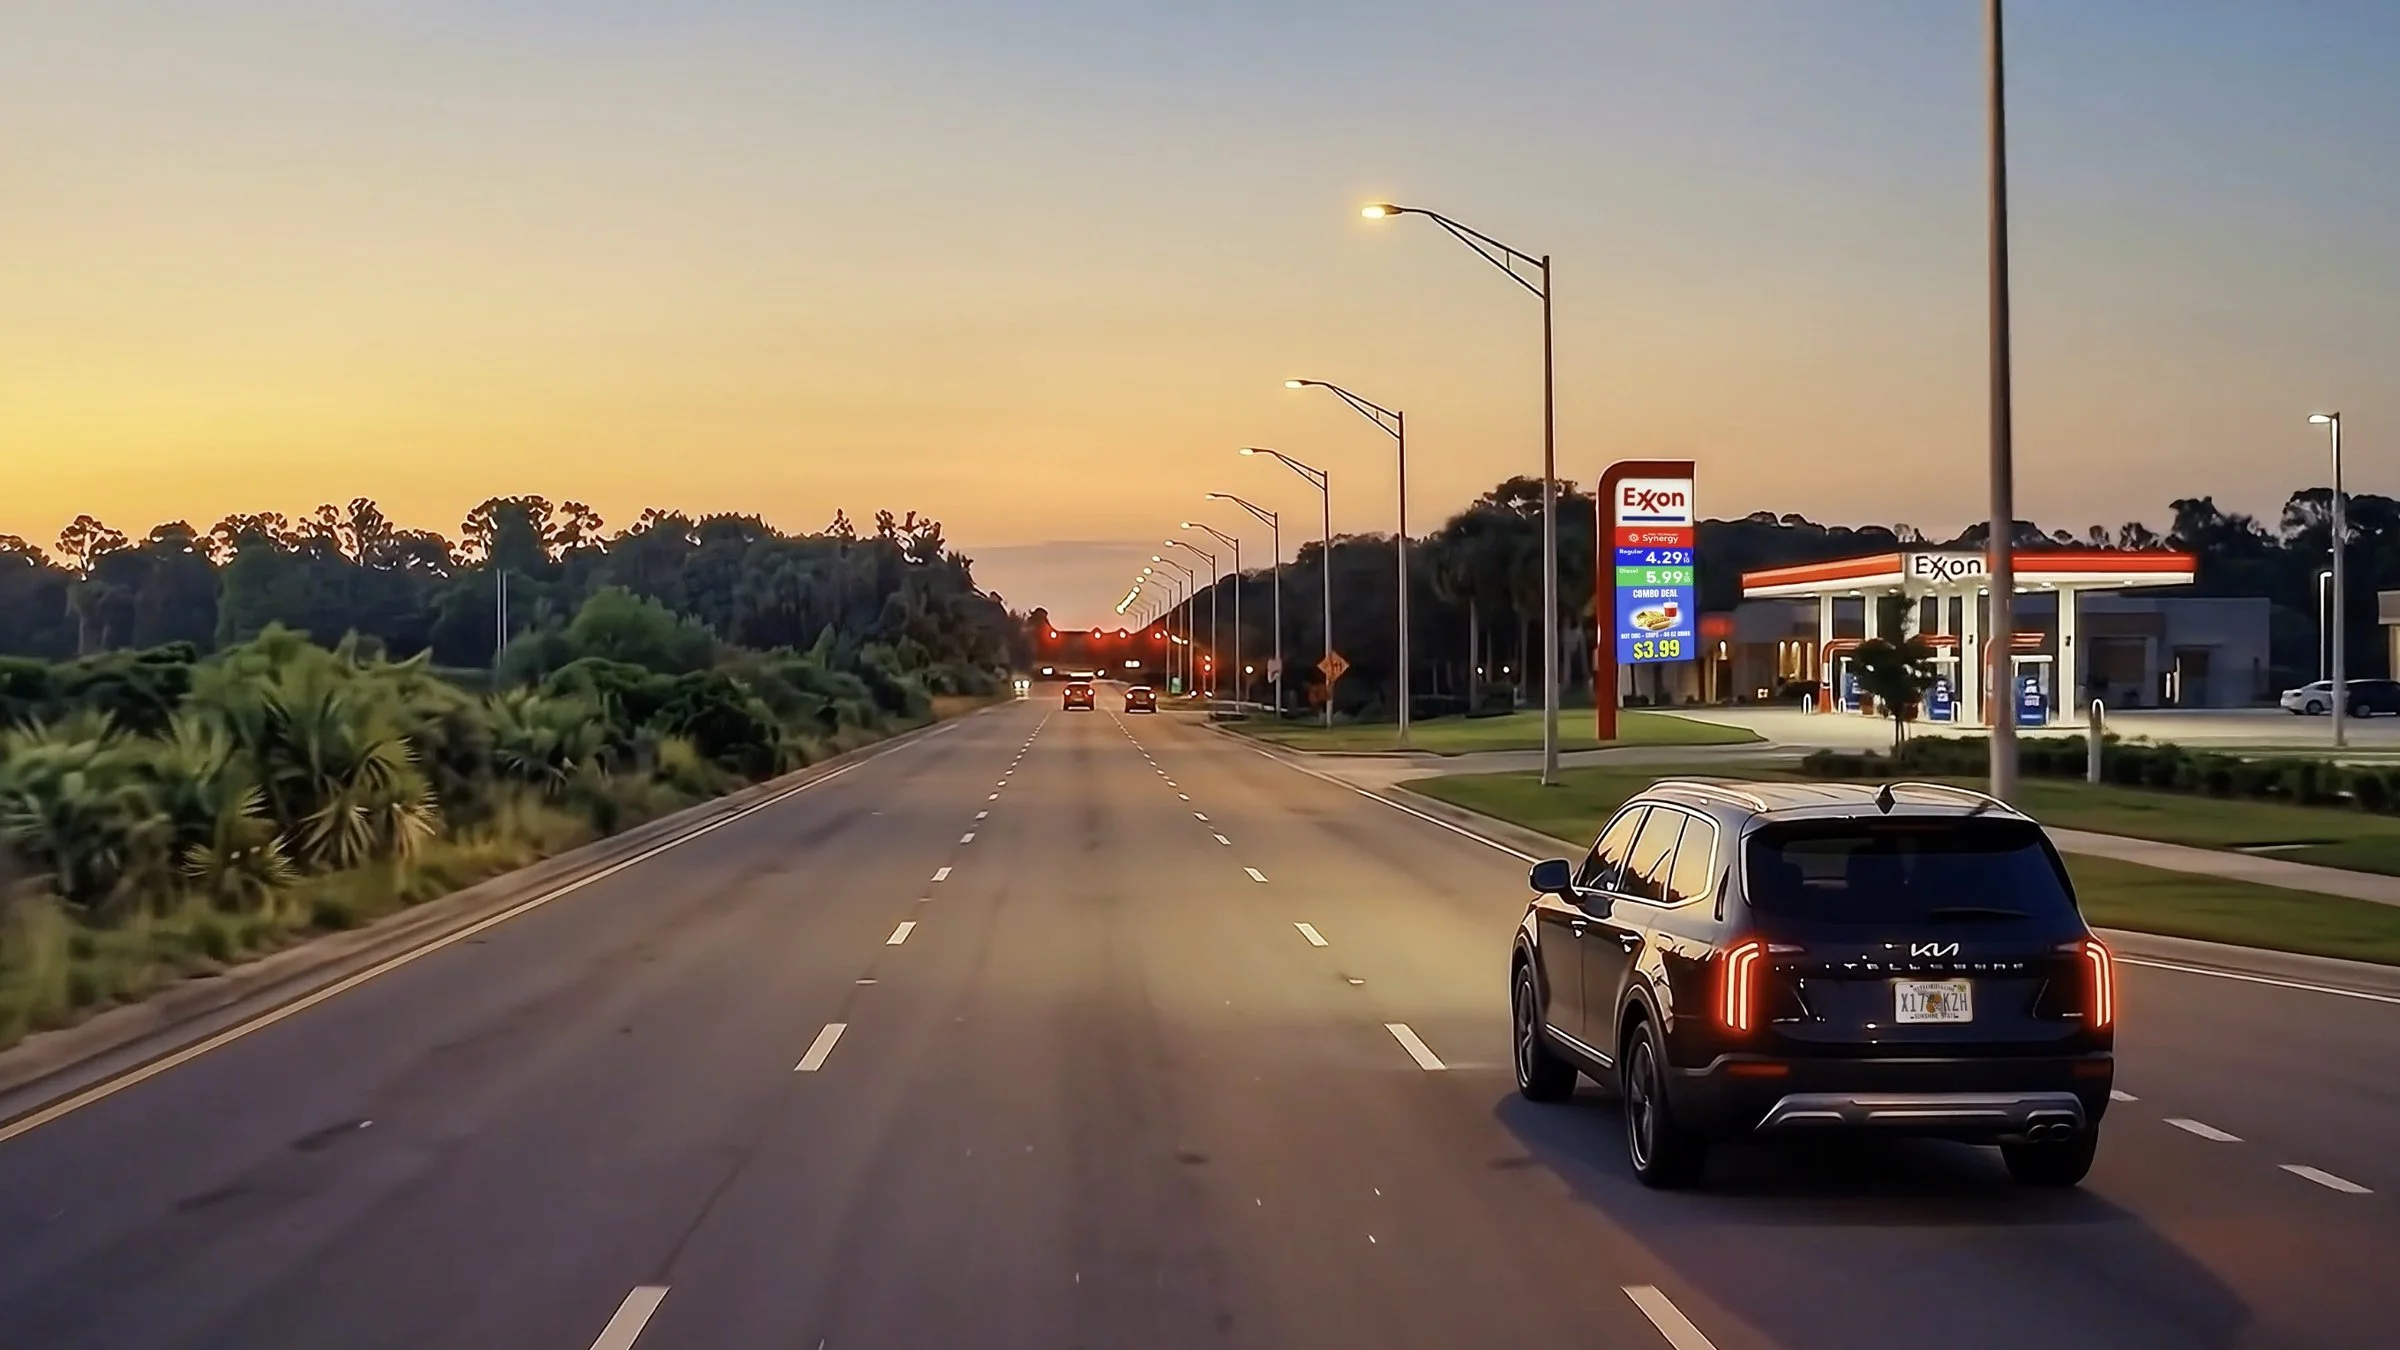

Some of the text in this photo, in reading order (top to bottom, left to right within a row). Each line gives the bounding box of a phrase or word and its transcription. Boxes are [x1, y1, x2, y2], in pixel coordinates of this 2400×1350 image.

[1624, 487, 1685, 513] Exxon
[1642, 534, 1679, 544] Synergy
[1645, 551, 1683, 564] 4.29
[1646, 570, 1683, 584] 5.99
[1915, 556, 1981, 583] Exxon
[1632, 588, 1678, 598] COMBO DEAL
[1633, 639, 1680, 660] $3.99
[1943, 993, 1968, 1012] KZH
